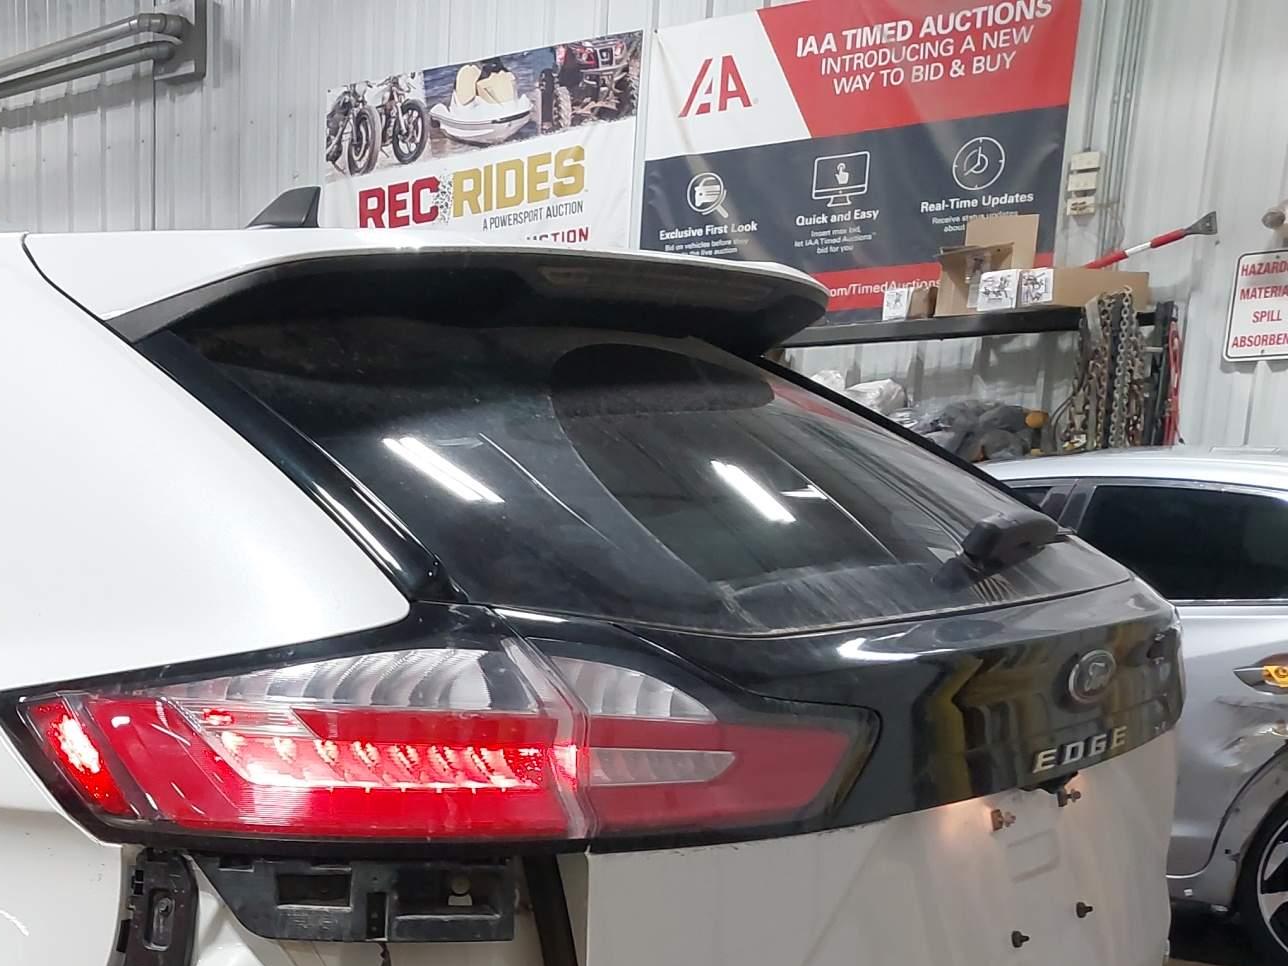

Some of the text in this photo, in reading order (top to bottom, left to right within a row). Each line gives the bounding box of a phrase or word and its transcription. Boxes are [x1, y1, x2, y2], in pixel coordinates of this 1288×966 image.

[796, 0, 1053, 58] IAA TIMED AUCTIONS
[821, 25, 1035, 76] INTRODUCING A NEW
[833, 50, 1017, 95] WAY TO BID & BUY
[358, 145, 584, 229] REC RIDES
[920, 193, 1034, 213] Real-Time Updates
[482, 200, 584, 232] A POWERSPORT AUCTION
[659, 221, 758, 240] Exclusive First Look
[795, 208, 880, 226] Quick and Easy
[1241, 260, 1288, 276] HAZARD
[1252, 310, 1283, 323] SPILL
[1032, 726, 1128, 774] EDGE
